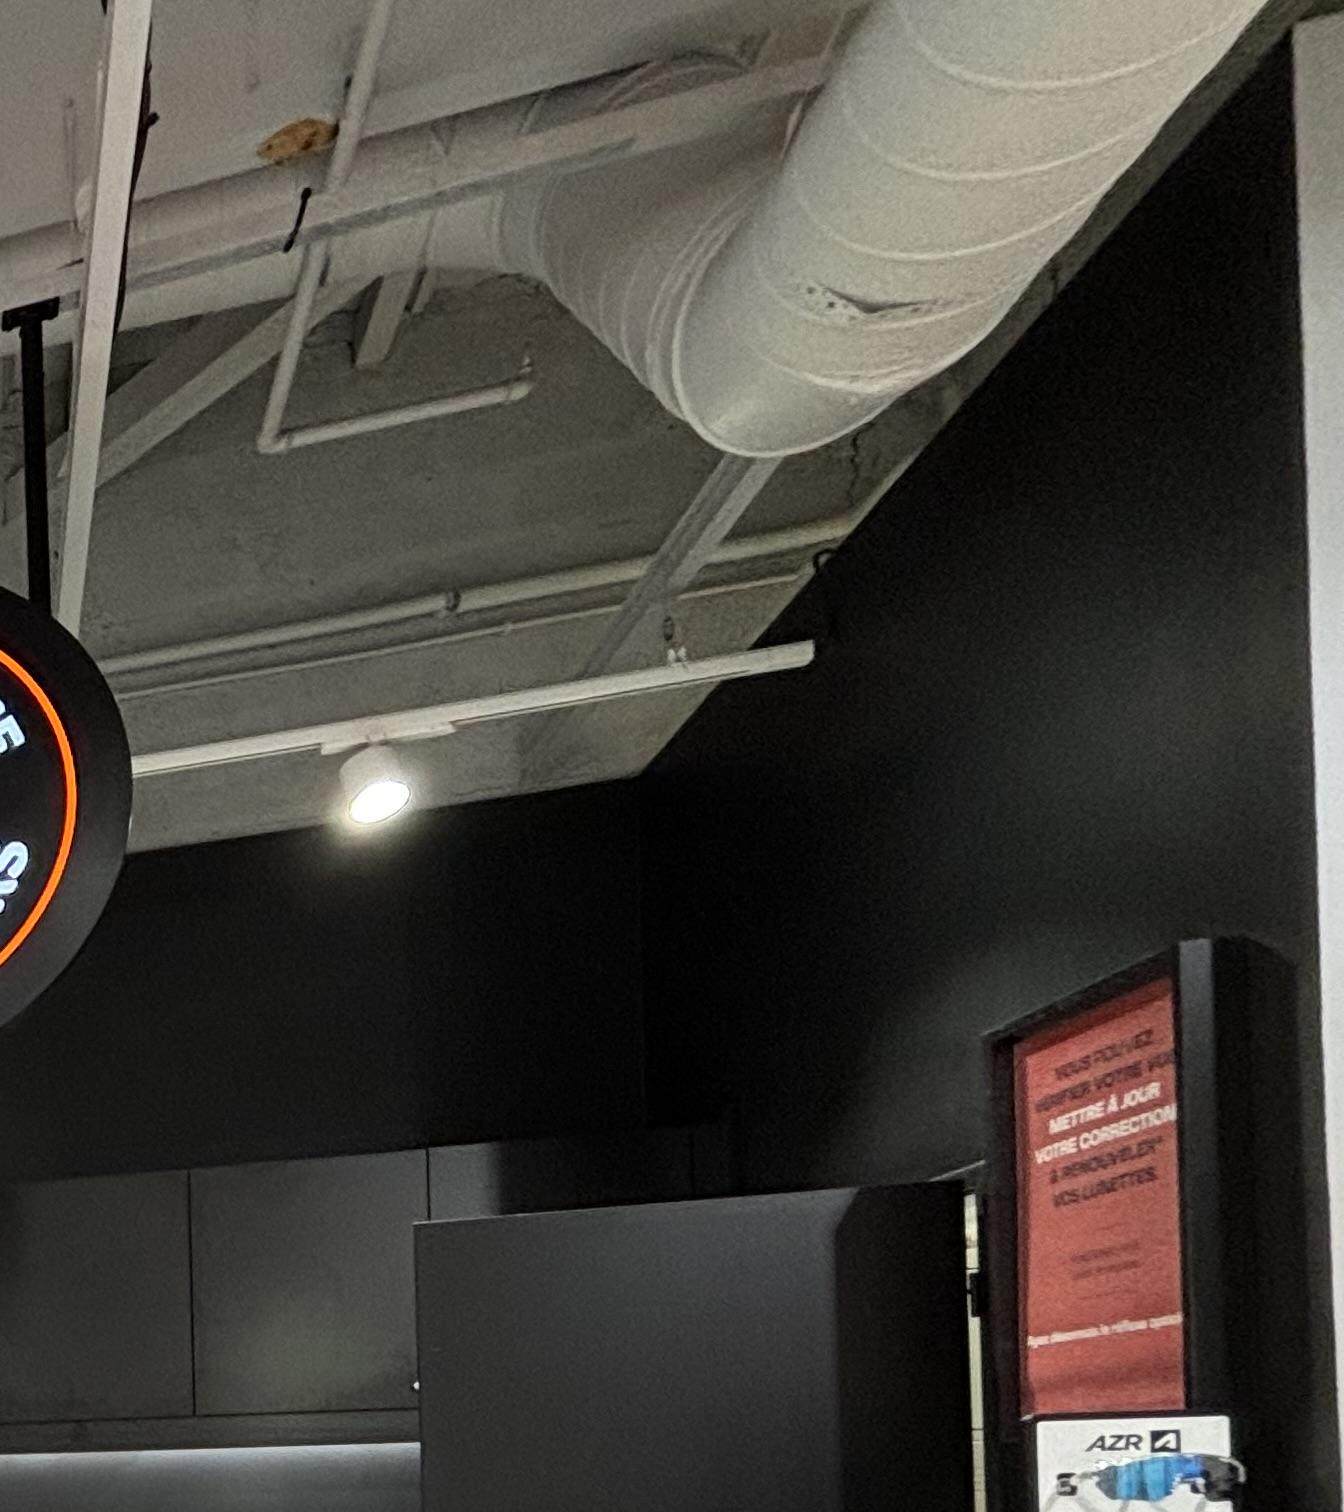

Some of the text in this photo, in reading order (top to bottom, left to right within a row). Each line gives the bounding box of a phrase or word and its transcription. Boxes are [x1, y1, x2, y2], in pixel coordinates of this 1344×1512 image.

[1048, 1100, 1106, 1135] METTRE
[1120, 1081, 1162, 1110] JOUR
[1079, 1103, 1178, 1151] CORRECTION
[1085, 1434, 1143, 1451] AZR
